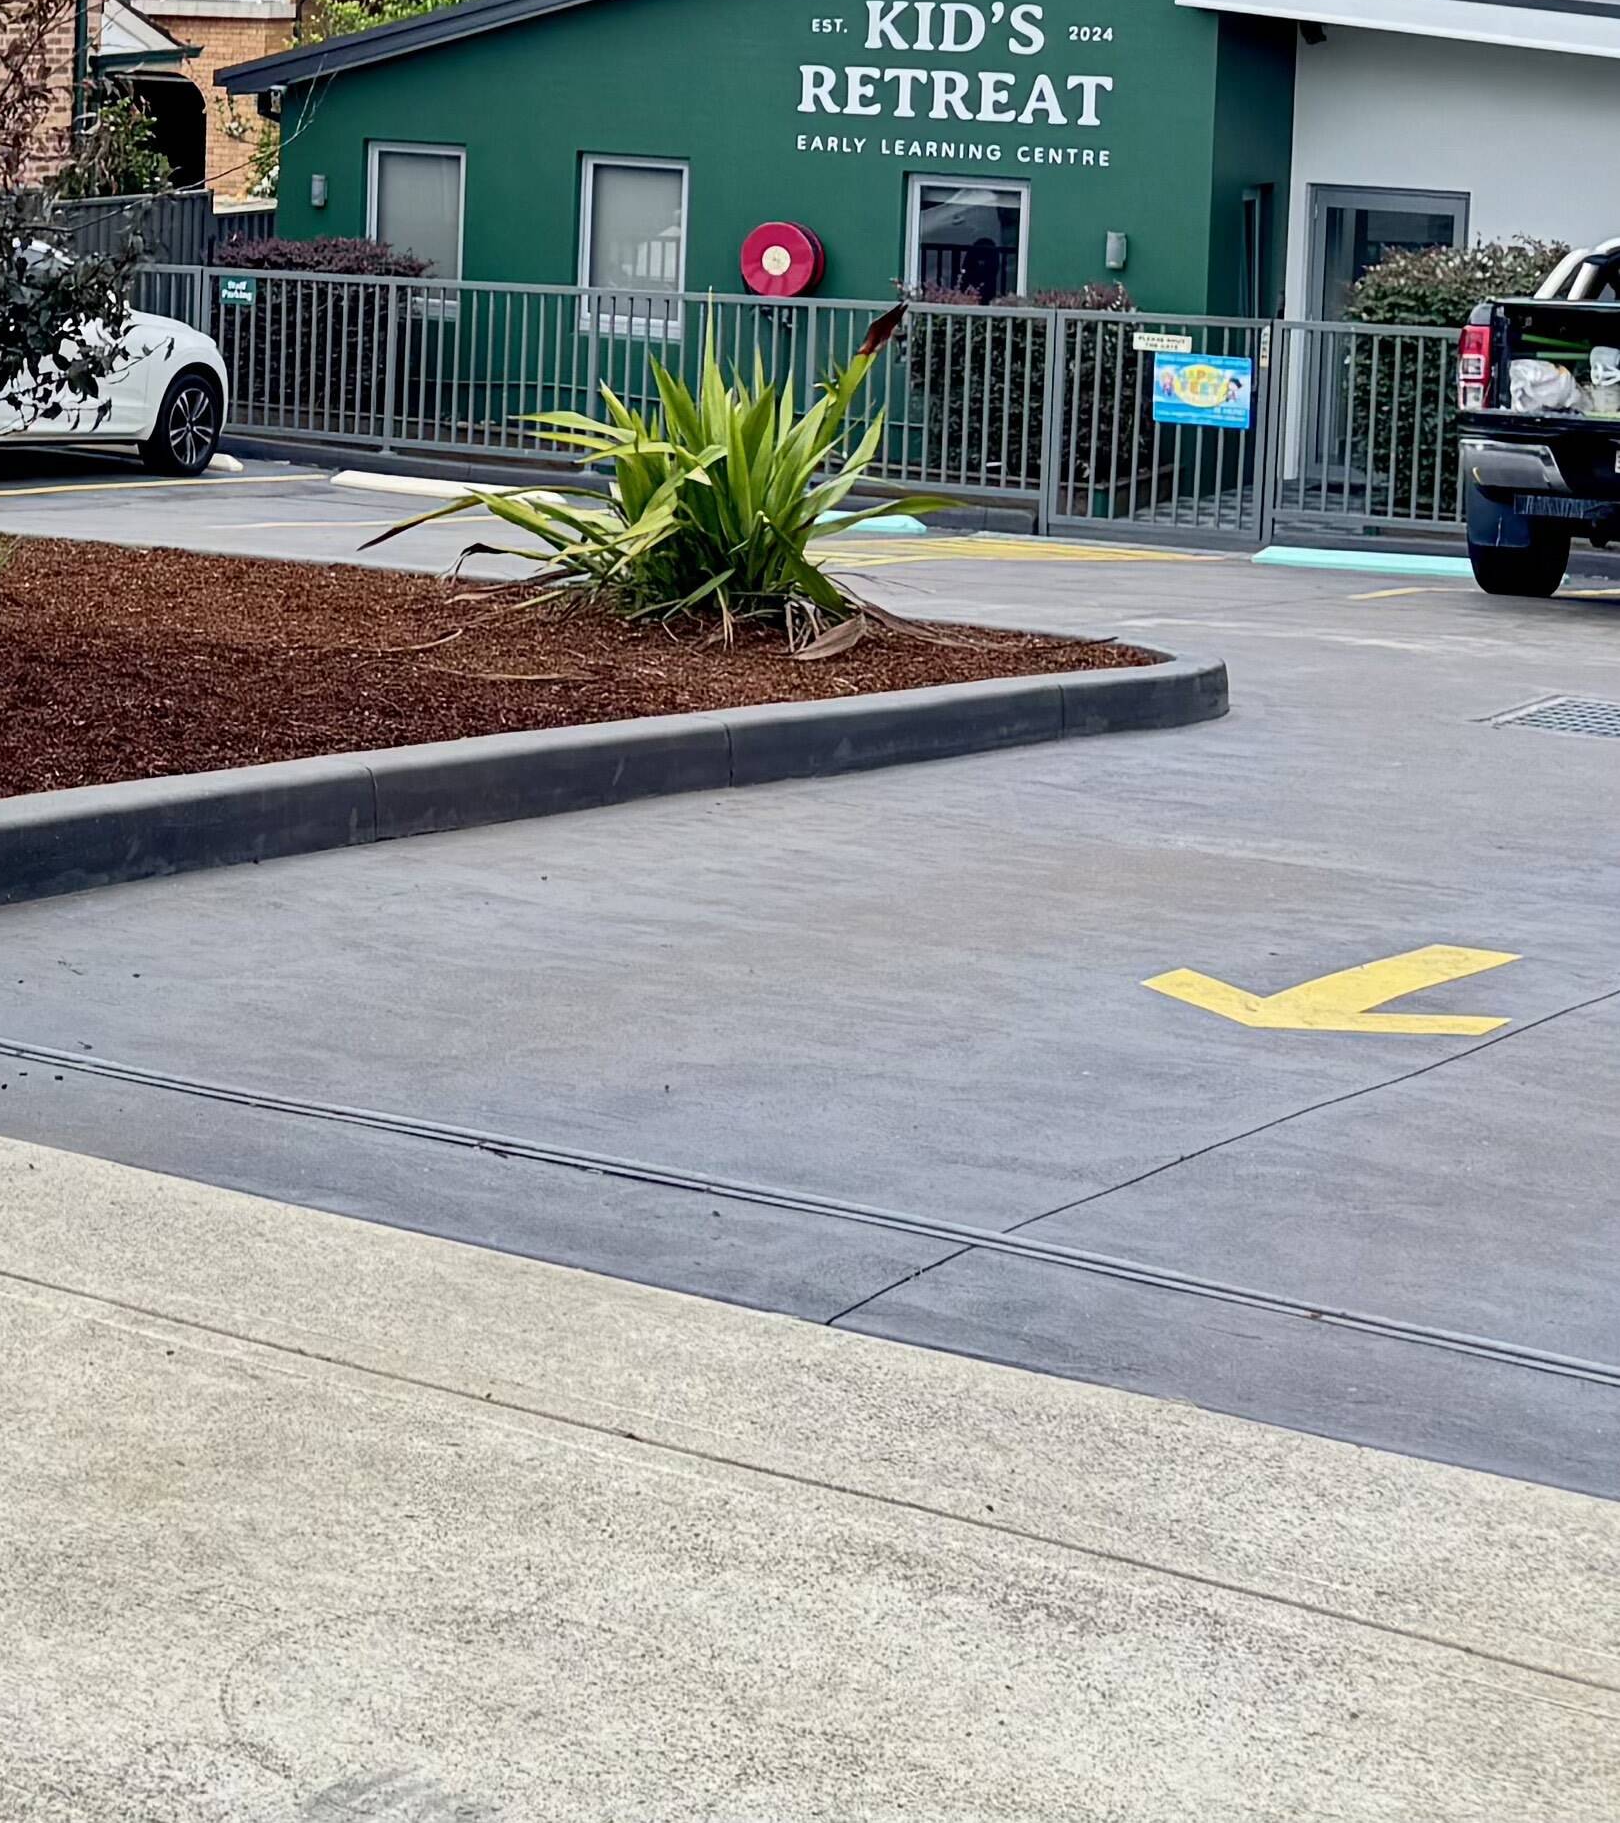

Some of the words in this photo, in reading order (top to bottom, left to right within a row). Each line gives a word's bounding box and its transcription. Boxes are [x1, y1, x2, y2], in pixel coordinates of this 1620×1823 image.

[811, 18, 848, 34] EST.
[864, 0, 1045, 56] KID'S
[1068, 25, 1114, 42] 2024
[797, 64, 1113, 127] RETREAT
[796, 134, 867, 154] EARLY
[881, 138, 1002, 162] LEARNING
[1017, 146, 1111, 168] CENTRE
